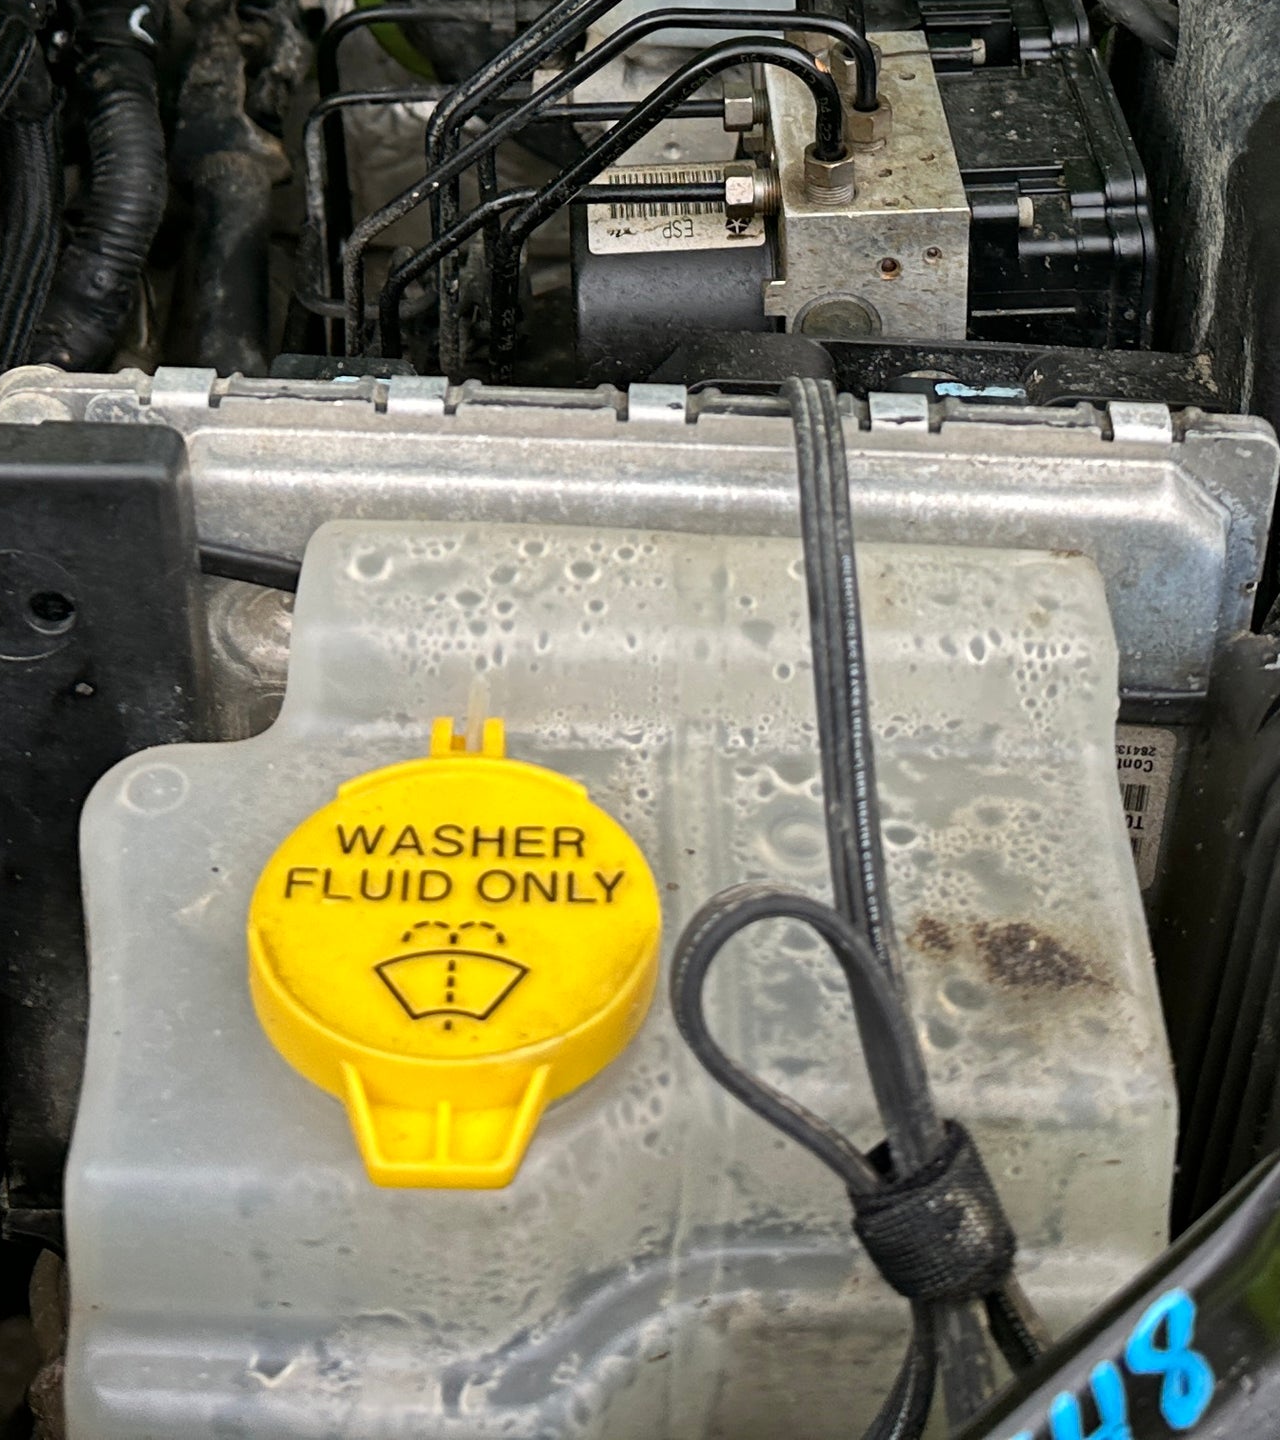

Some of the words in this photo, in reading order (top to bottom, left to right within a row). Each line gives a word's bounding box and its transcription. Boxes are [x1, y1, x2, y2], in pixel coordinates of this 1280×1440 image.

[662, 218, 694, 239] ESP
[336, 823, 586, 858] WASHER
[284, 866, 453, 902] FLUID
[475, 868, 625, 904] ONLY
